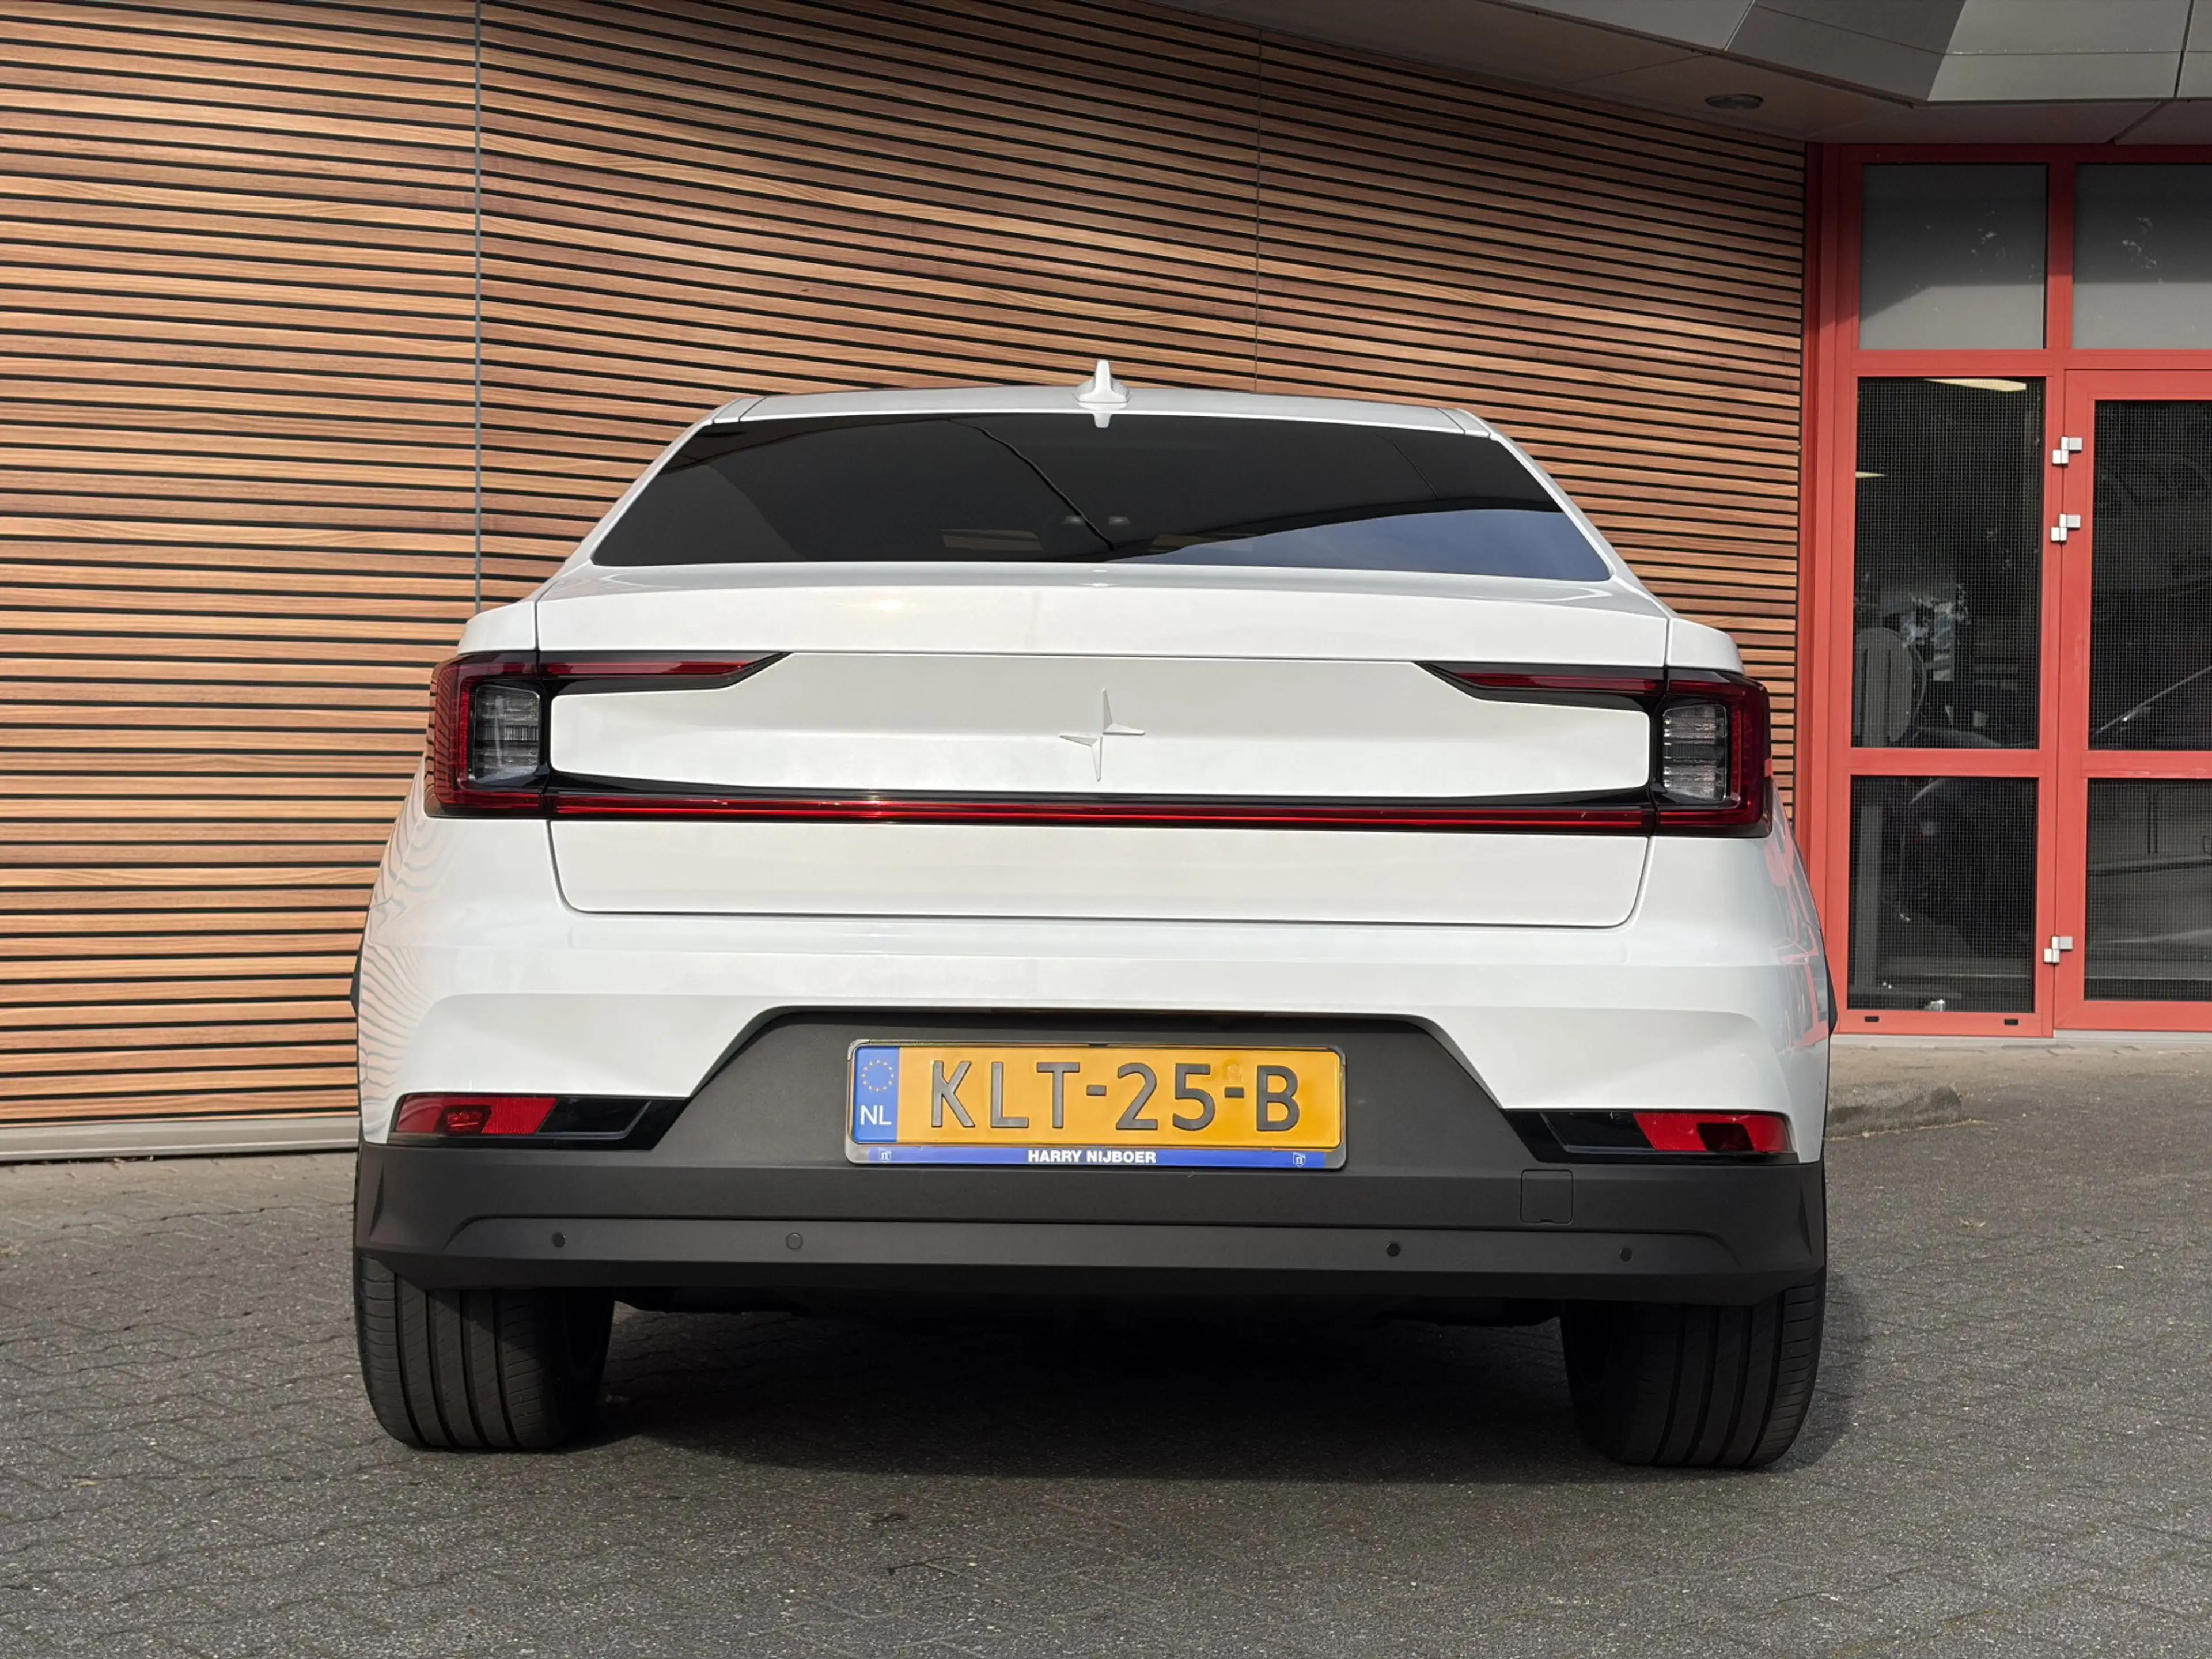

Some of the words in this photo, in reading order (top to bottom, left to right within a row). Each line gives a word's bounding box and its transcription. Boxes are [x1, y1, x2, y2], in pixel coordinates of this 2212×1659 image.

[931, 1061, 1300, 1132] KLT-25-B
[860, 1105, 892, 1126] NL
[1028, 1149, 1082, 1162] HARRY
[1086, 1150, 1157, 1164] NIJBOER
